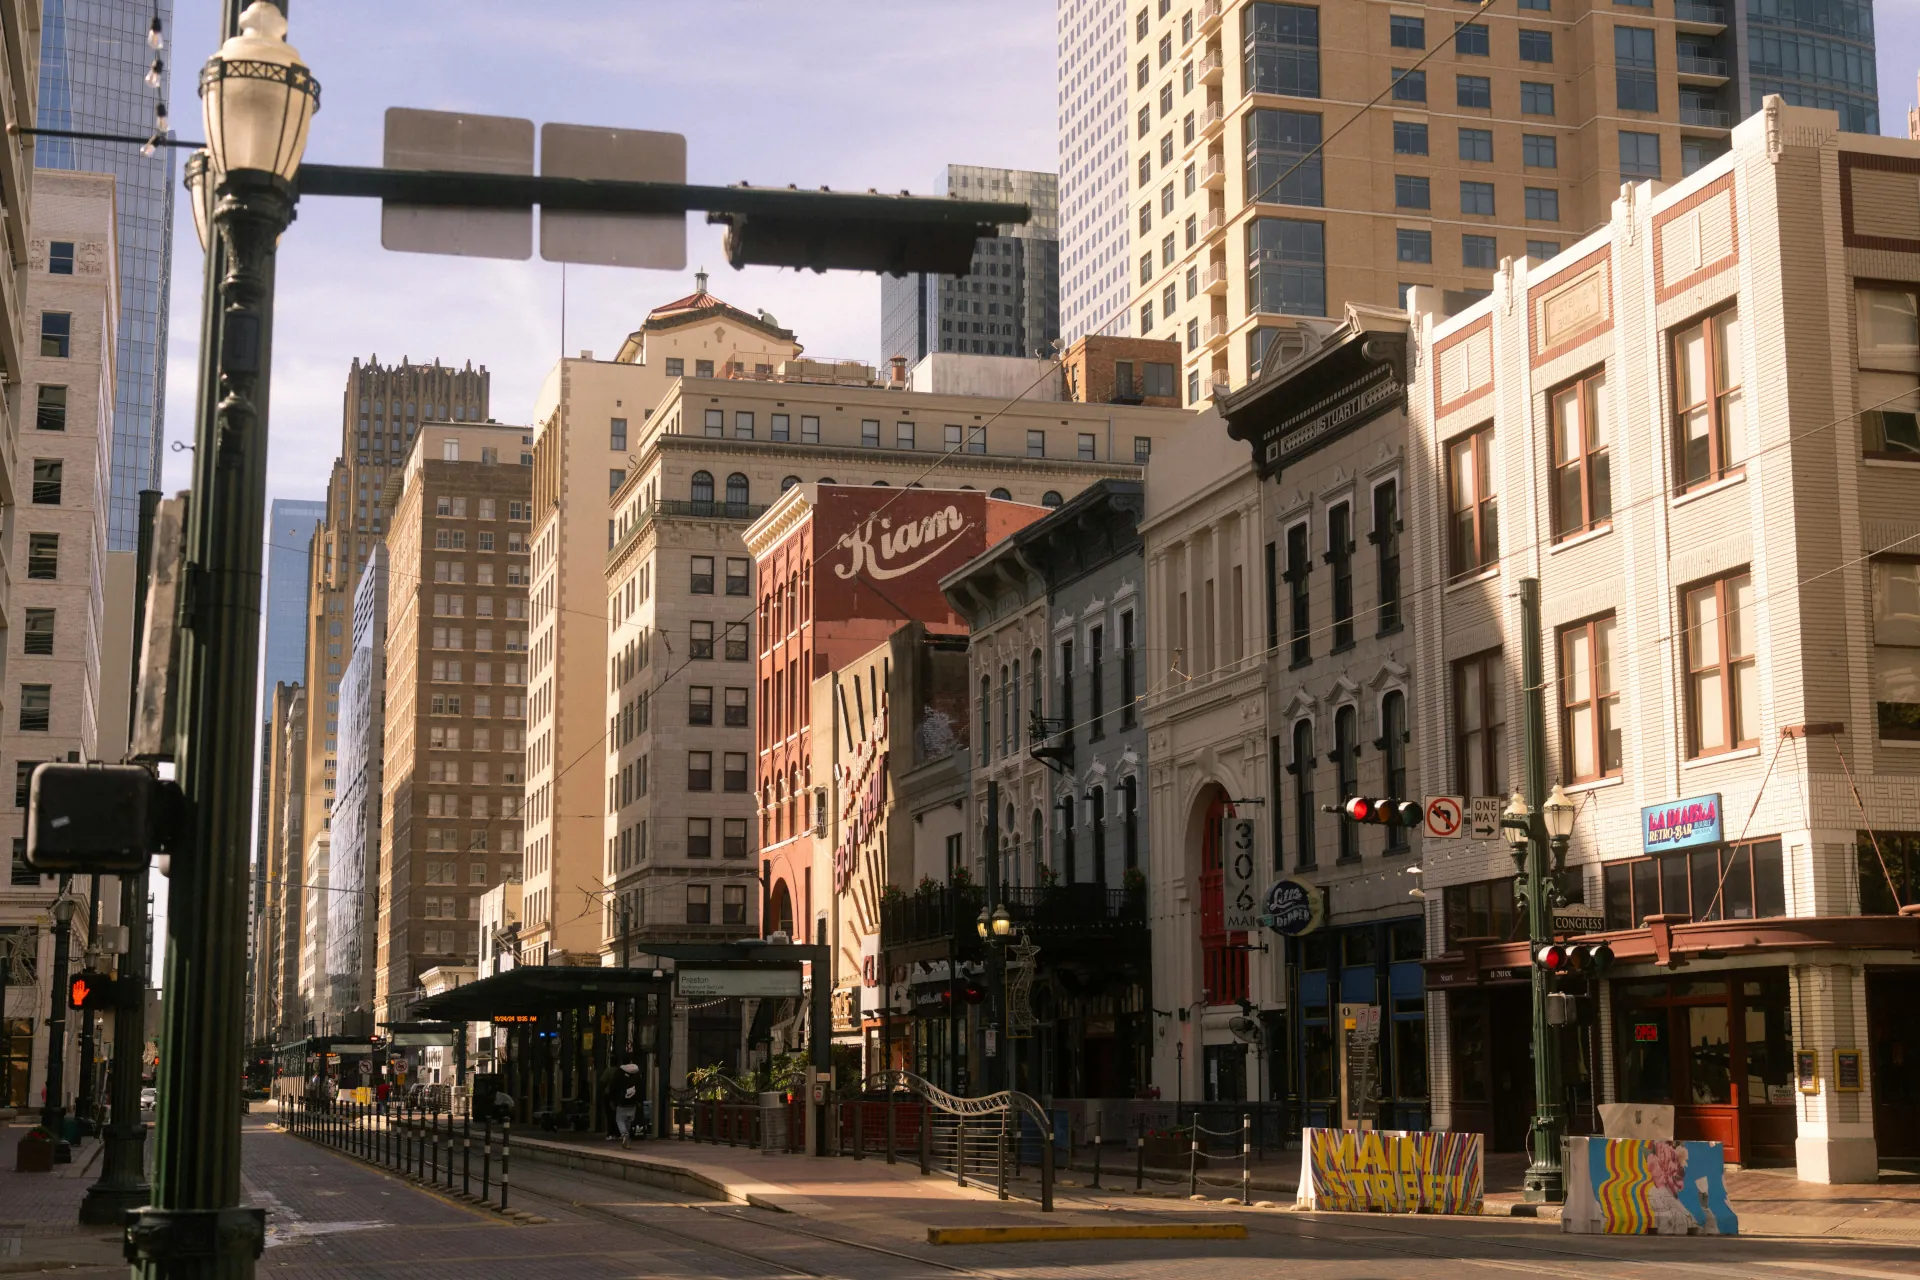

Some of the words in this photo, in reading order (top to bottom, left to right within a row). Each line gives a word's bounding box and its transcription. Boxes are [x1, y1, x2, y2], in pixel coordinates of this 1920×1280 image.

[1319, 402, 1356, 431] STUART
[834, 505, 974, 580] Kiam
[1475, 801, 1496, 811] ONE
[1474, 813, 1497, 822] WAY
[1648, 811, 1665, 831] LA
[1667, 801, 1716, 827] DIABLA
[1235, 822, 1254, 911] 306
[1276, 909, 1310, 927] DIPPER
[1555, 917, 1602, 930] CONGRESS
[681, 976, 709, 984] Preston
[1636, 1025, 1657, 1040] OPEN
[1317, 1132, 1432, 1172] MAIN
